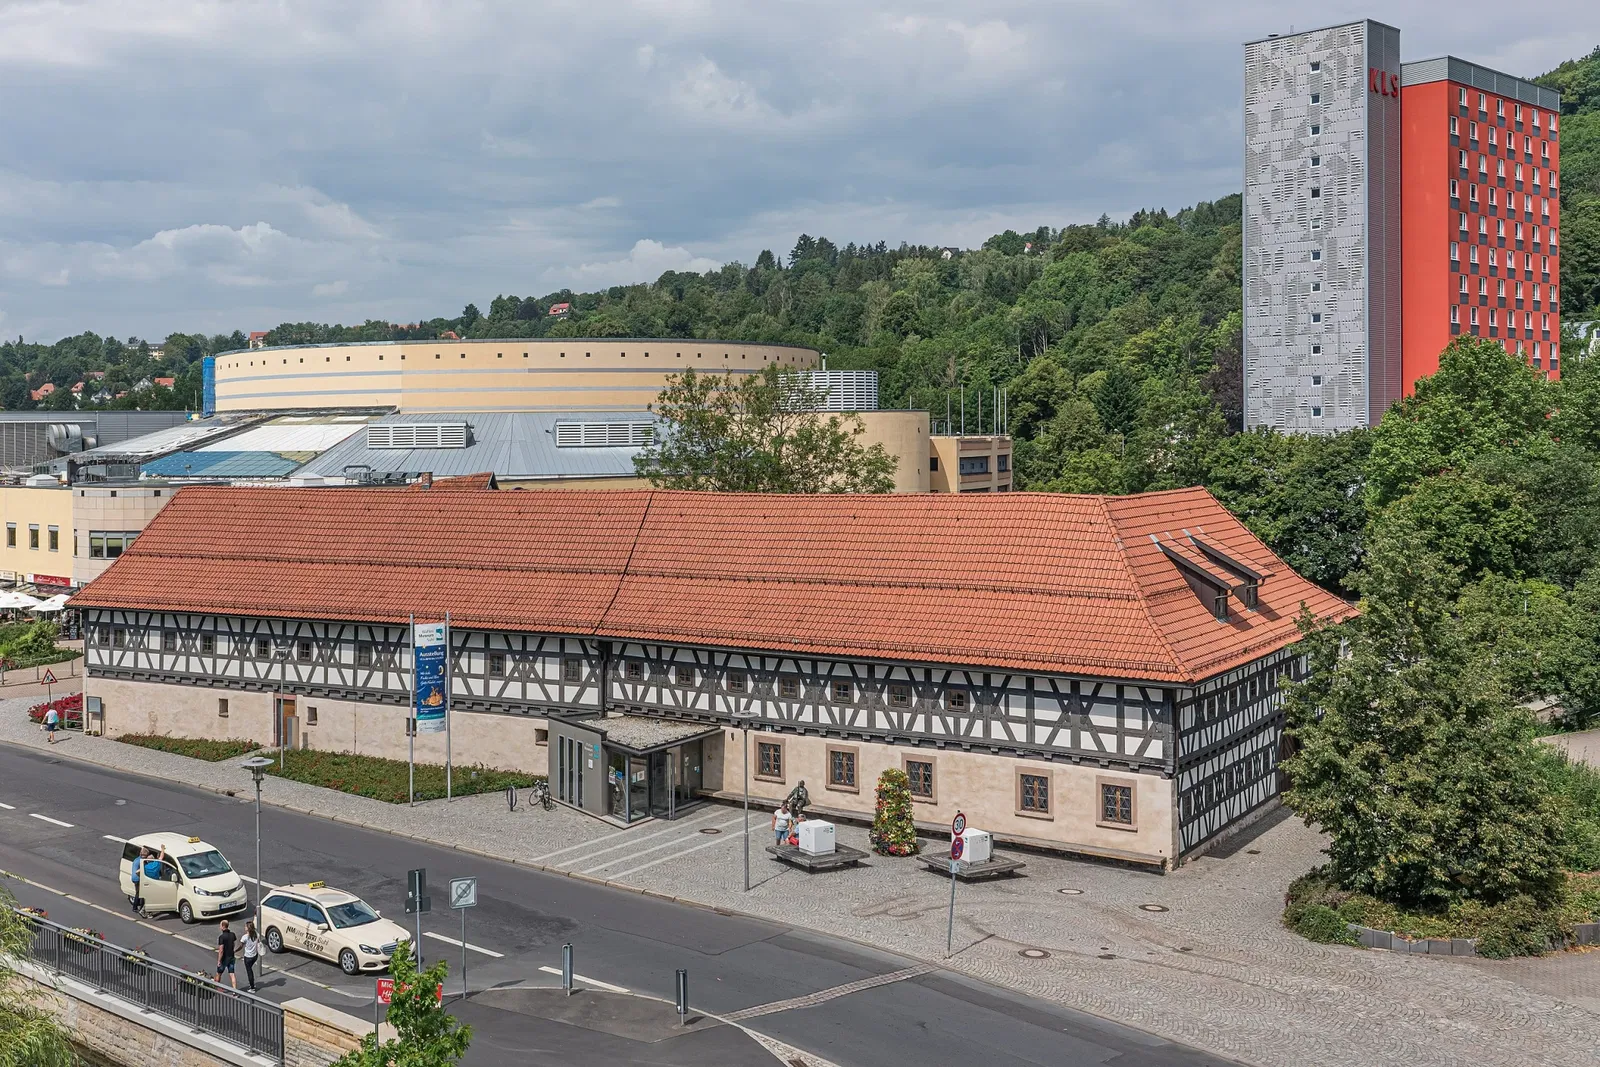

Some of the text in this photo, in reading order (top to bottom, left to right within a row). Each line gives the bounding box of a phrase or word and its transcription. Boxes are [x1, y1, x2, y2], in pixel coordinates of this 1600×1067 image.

[1369, 67, 1399, 98] KLS
[955, 818, 964, 831] 30
[303, 940, 324, 951] 456789
